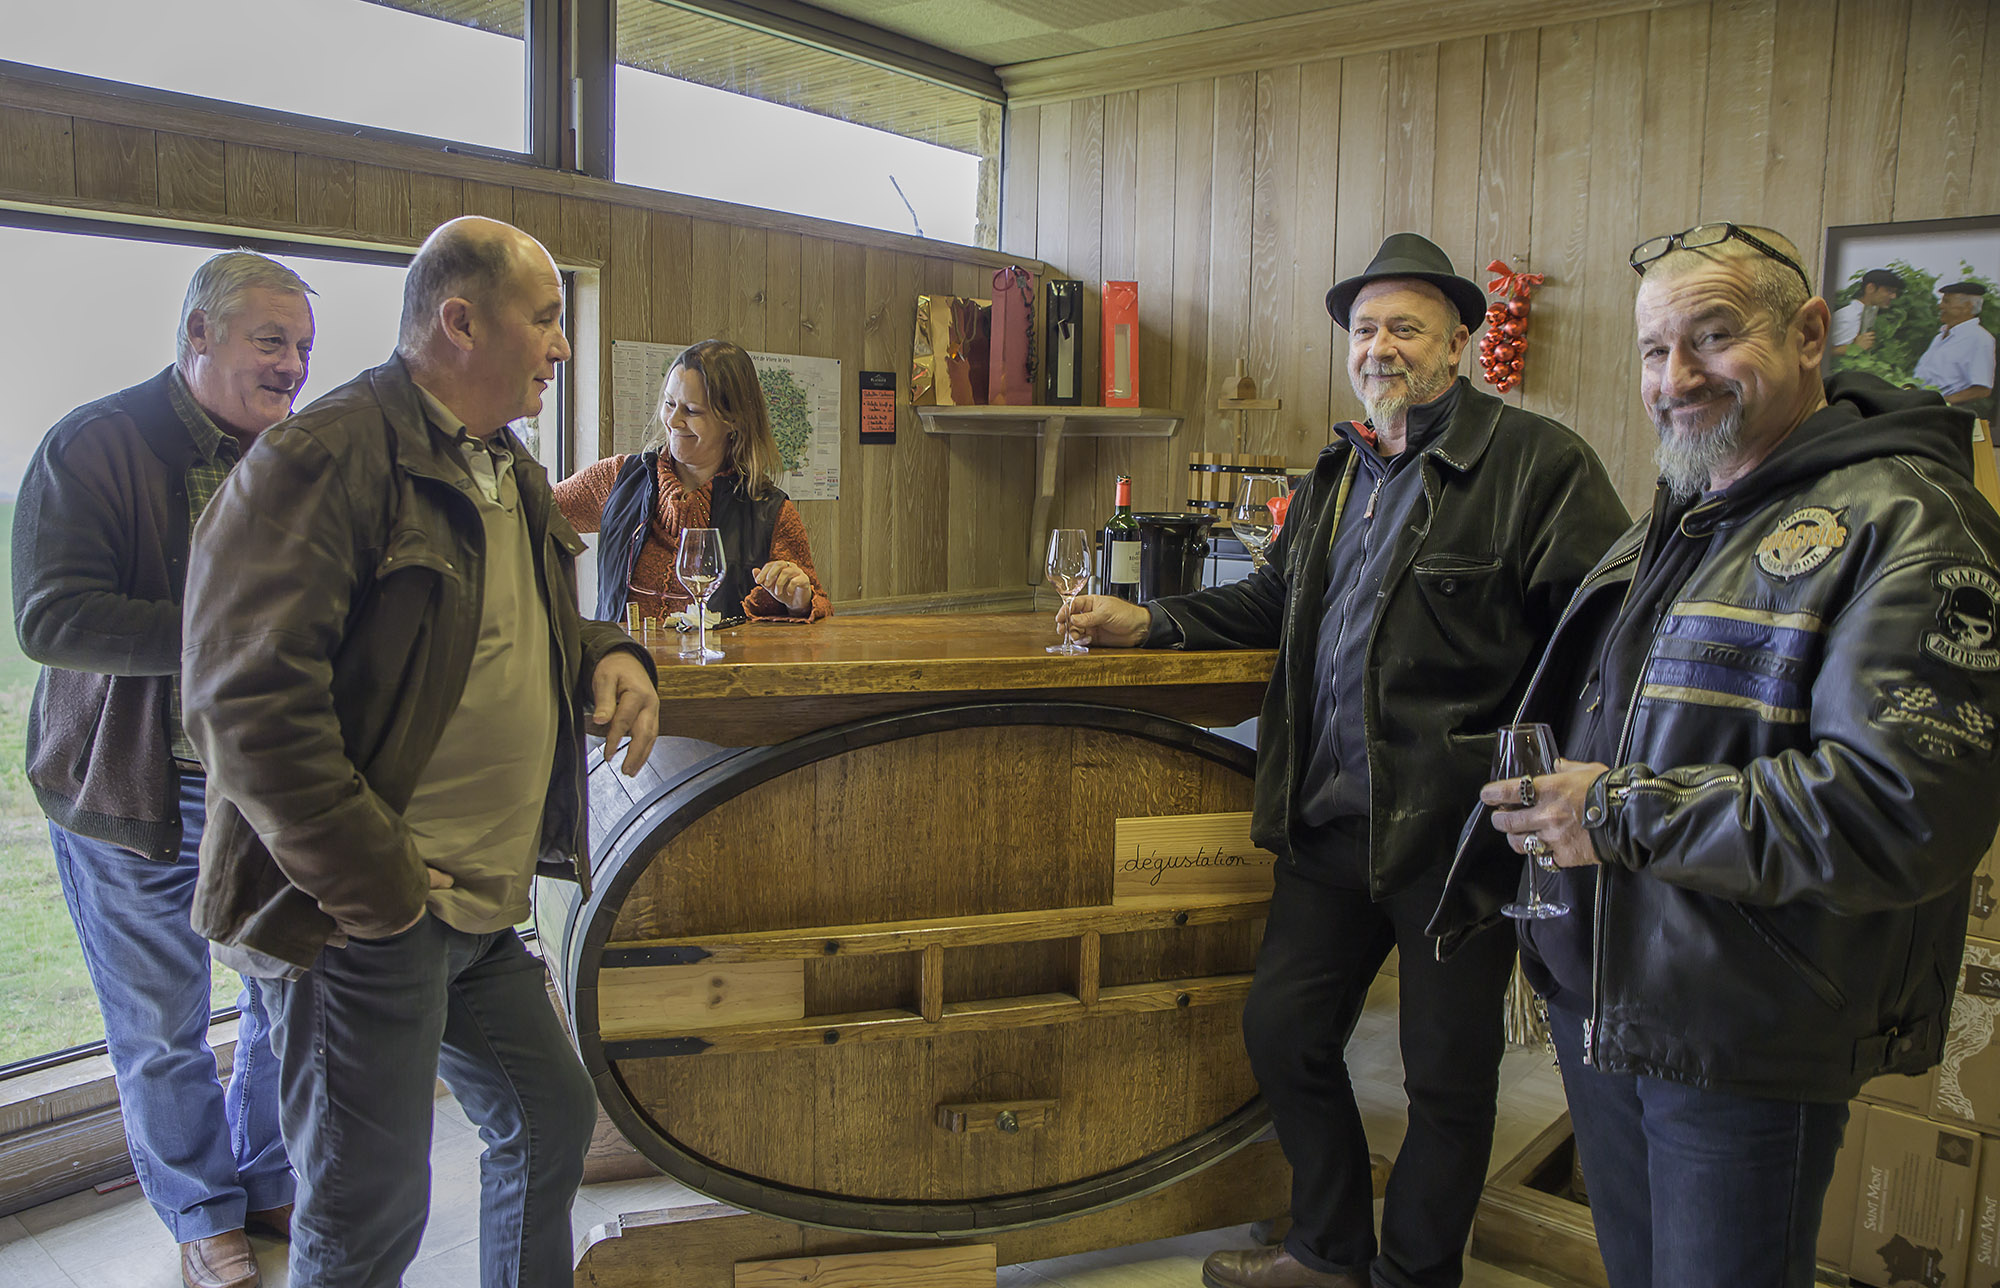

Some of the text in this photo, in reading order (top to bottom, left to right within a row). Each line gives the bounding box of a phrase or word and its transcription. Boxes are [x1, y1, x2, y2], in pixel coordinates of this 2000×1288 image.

[1946, 570, 2000, 593] HARLEY
[1933, 638, 2000, 667] DAVIDSON
[1119, 844, 1251, 886] dégustation
[1863, 1165, 1883, 1232] SAINT MONT
[1980, 1195, 1998, 1232] MONT
[1977, 1232, 1994, 1265] SAINT
